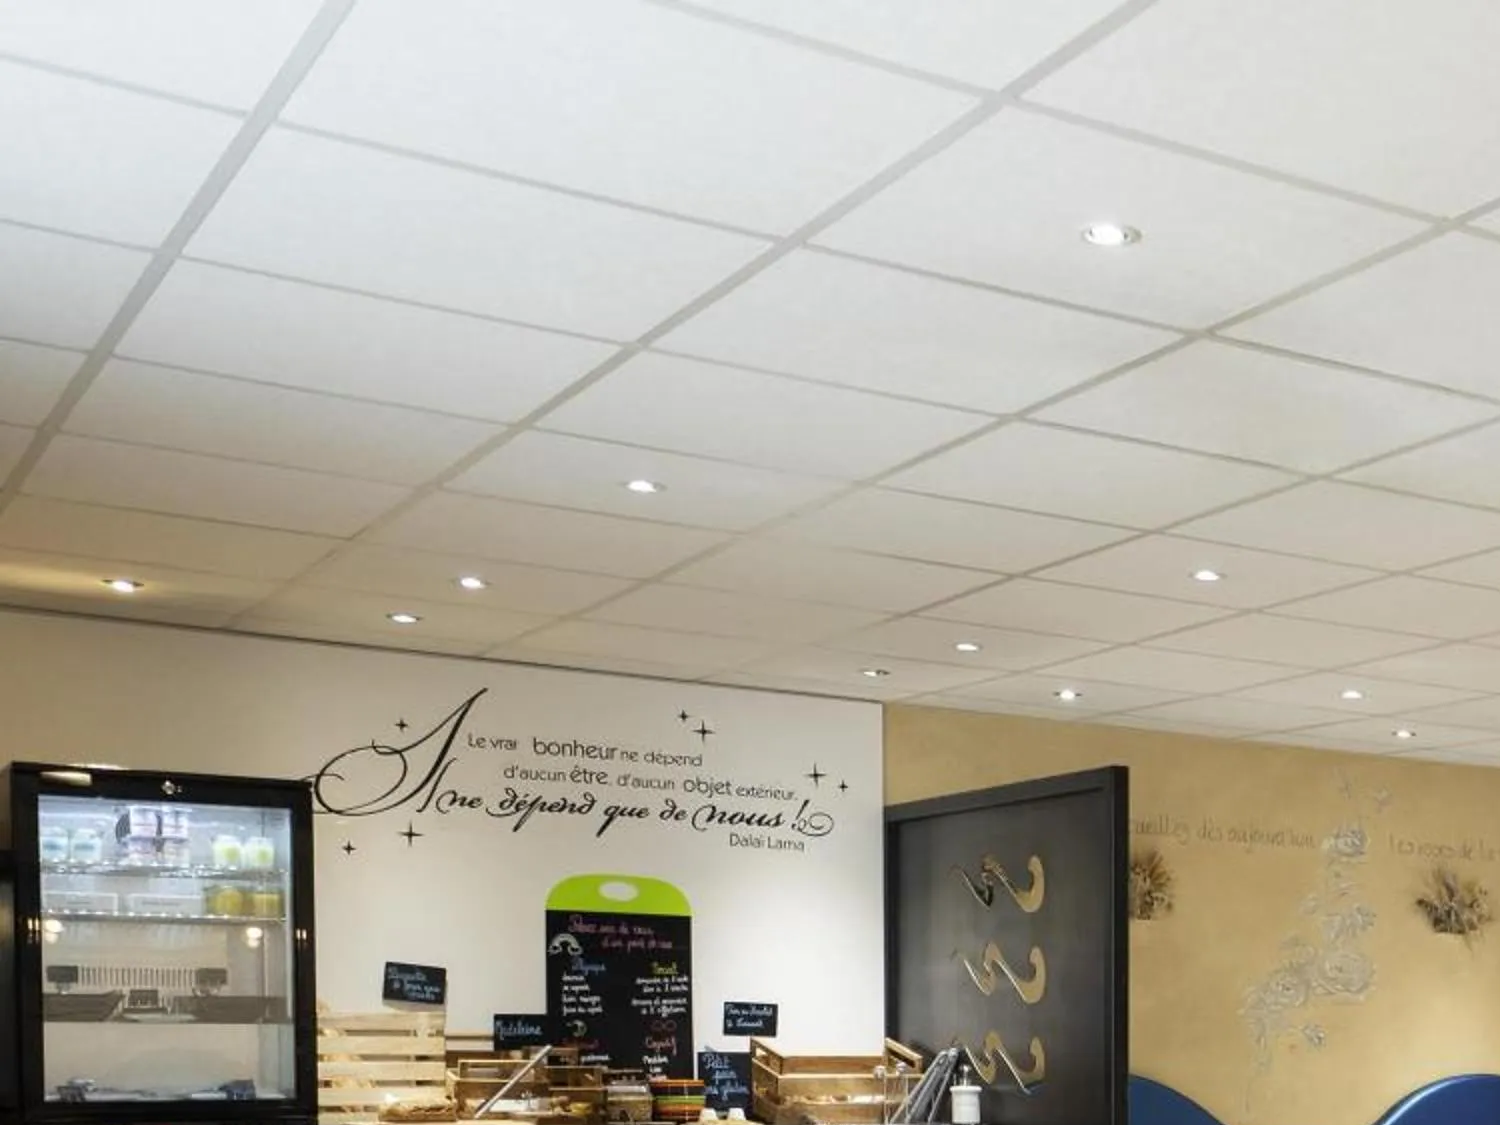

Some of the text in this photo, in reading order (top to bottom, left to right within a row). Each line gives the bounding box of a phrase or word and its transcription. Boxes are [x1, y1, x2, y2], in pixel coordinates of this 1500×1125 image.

[468, 733, 703, 768] Le vrai bonheur ne dépend
[503, 764, 567, 782] d'aucun
[616, 773, 675, 791] d'aucun
[683, 776, 732, 799] objet
[436, 789, 483, 814] ne
[486, 787, 598, 833] dépend
[595, 804, 650, 838] que
[659, 799, 688, 821] de
[691, 804, 785, 832] nous
[768, 836, 805, 852] Lama
